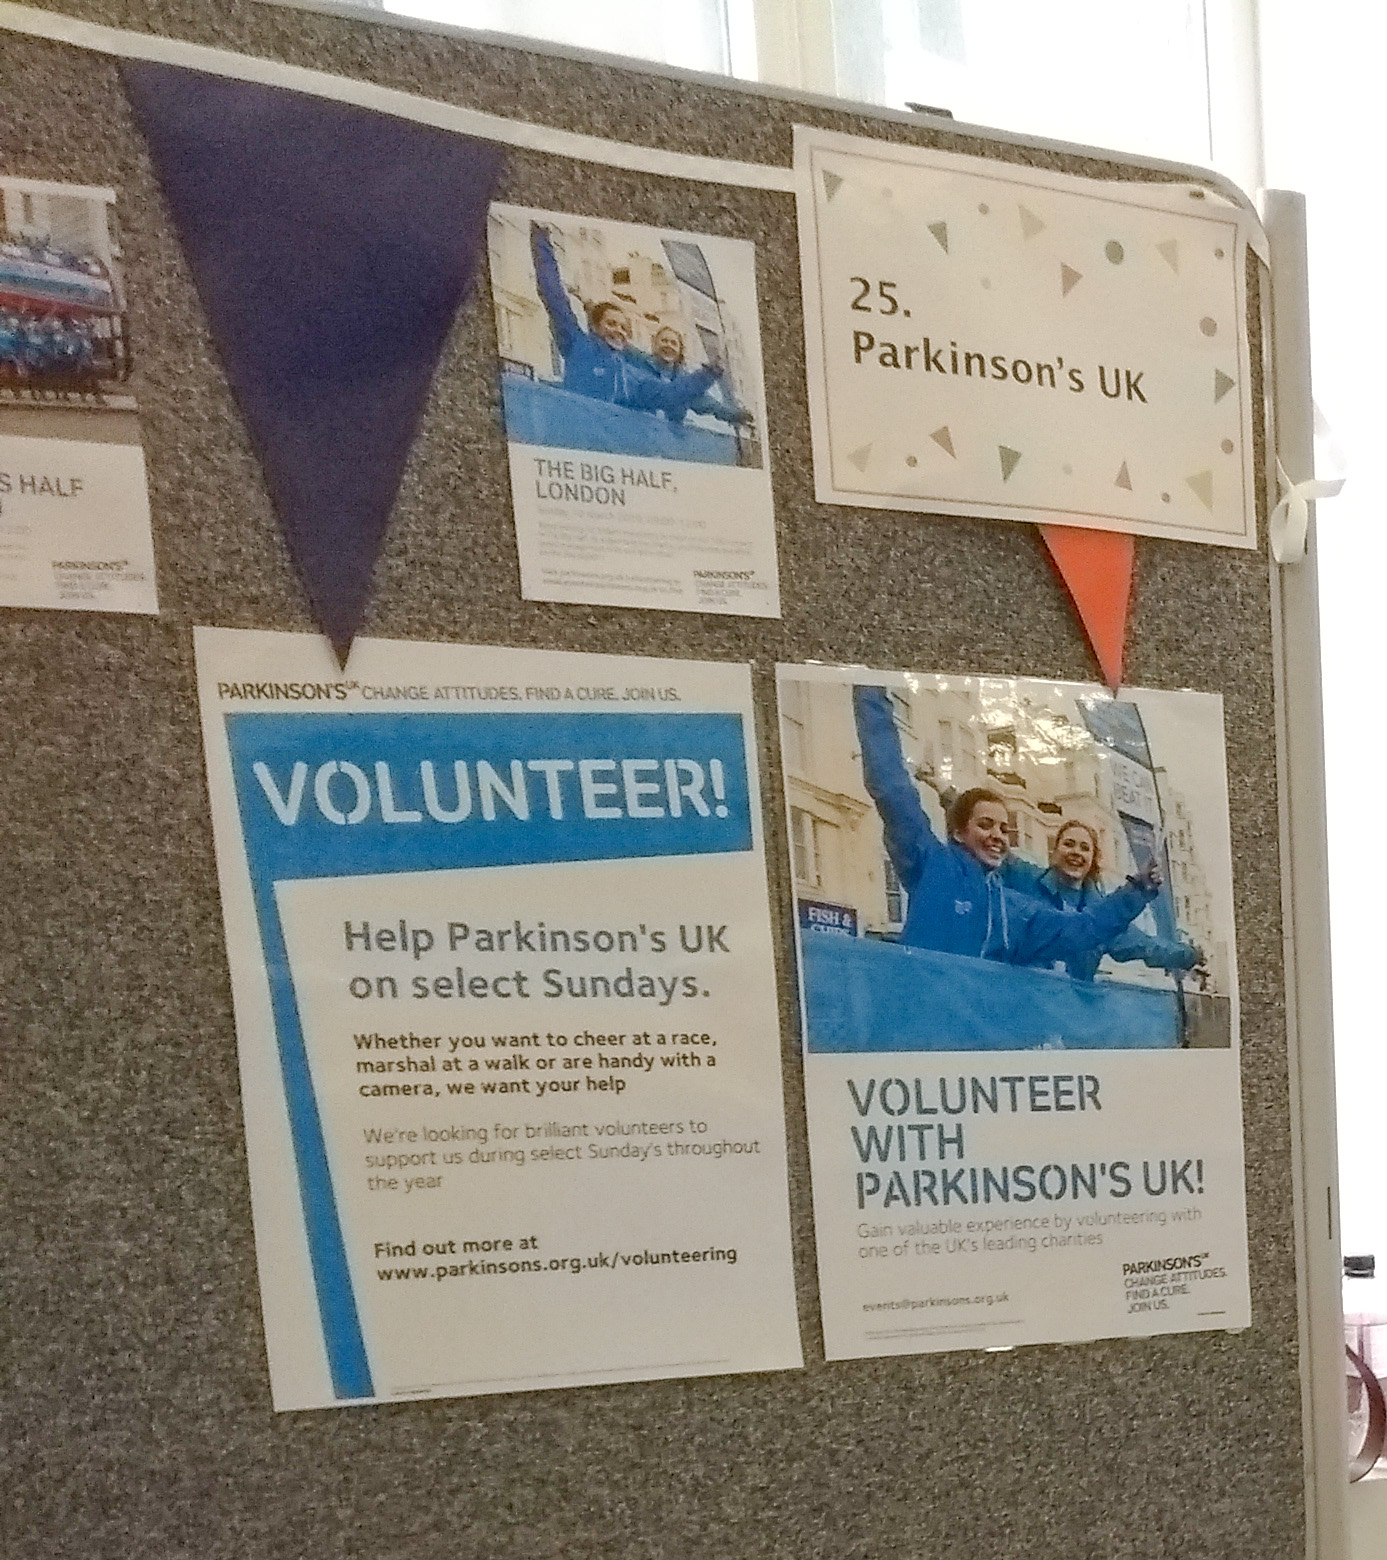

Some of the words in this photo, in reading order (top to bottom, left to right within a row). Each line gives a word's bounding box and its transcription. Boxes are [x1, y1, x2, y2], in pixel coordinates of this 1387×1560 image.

[849, 276, 912, 317] 25.
[852, 330, 1085, 394] Parkinson's
[1098, 365, 1149, 404] UK
[534, 459, 574, 480] THE
[581, 462, 615, 484] BIG
[19, 473, 84, 498] HALF
[535, 480, 627, 506] LONDON
[362, 686, 429, 701] CHANGE
[434, 686, 522, 701] ATTITUDES.
[525, 687, 561, 701] FIND
[564, 687, 574, 700] A
[576, 687, 619, 701] CURE.
[622, 687, 656, 701] JOIN
[658, 687, 681, 702] US.
[252, 758, 730, 827] VOLUNTEER!
[808, 906, 840, 926] FISH
[345, 920, 434, 959] Help
[448, 922, 667, 952] Parkinson's
[679, 924, 729, 953] UK
[349, 976, 398, 999] on
[412, 967, 530, 999] select
[543, 968, 709, 1006] Sundays.
[354, 1032, 441, 1050] Whether
[449, 1036, 486, 1053] you
[491, 1033, 541, 1048] want
[546, 1033, 568, 1047] to
[574, 1031, 626, 1047] cheer
[632, 1031, 651, 1045] at
[657, 1033, 666, 1045] a
[672, 1034, 717, 1046] race,
[357, 1055, 436, 1073] marshal
[442, 1057, 463, 1072] at
[468, 1059, 479, 1071] a
[485, 1054, 530, 1071] walk
[536, 1058, 556, 1070] or
[563, 1057, 593, 1070] are
[598, 1052, 654, 1072] handy
[660, 1052, 701, 1067] with
[707, 1056, 716, 1067] a
[359, 1083, 440, 1097] camera,
[447, 1083, 475, 1095] we
[481, 1079, 530, 1094] want
[536, 1080, 580, 1098] your
[586, 1075, 626, 1094] help
[847, 1075, 1101, 1116] VOLUNTEER
[363, 1128, 418, 1144] We're
[422, 1126, 489, 1145] looking
[493, 1123, 519, 1140] for
[525, 1121, 589, 1139] brilliant
[594, 1121, 684, 1136] volunteers
[689, 1119, 708, 1133] to
[851, 1124, 964, 1162] WITH
[365, 1151, 437, 1170] support
[443, 1152, 463, 1165] us
[468, 1148, 525, 1167] during
[531, 1146, 582, 1161] select
[588, 1143, 662, 1162] Sunday's
[667, 1140, 760, 1159] throughout
[367, 1176, 398, 1190] the
[404, 1176, 443, 1193] year
[857, 1163, 1132, 1207] PARKINSON'S
[1143, 1159, 1204, 1196] UK!
[857, 1222, 893, 1239] Gain
[897, 1219, 962, 1236] valuable
[966, 1217, 1052, 1233] experience
[1052, 1213, 1072, 1232] by
[1077, 1211, 1167, 1227] volunteering
[1171, 1207, 1202, 1222] with
[374, 1240, 416, 1258] Find
[422, 1240, 456, 1256] out
[463, 1239, 513, 1253] more
[519, 1236, 538, 1250] at
[858, 1246, 888, 1259] one
[893, 1239, 909, 1256] of
[914, 1241, 941, 1255] the
[945, 1237, 978, 1254] UK's
[983, 1235, 1037, 1253] leading
[1041, 1233, 1103, 1248] charities
[377, 1250, 737, 1280] www.parkinsons.org.uk/volunteering
